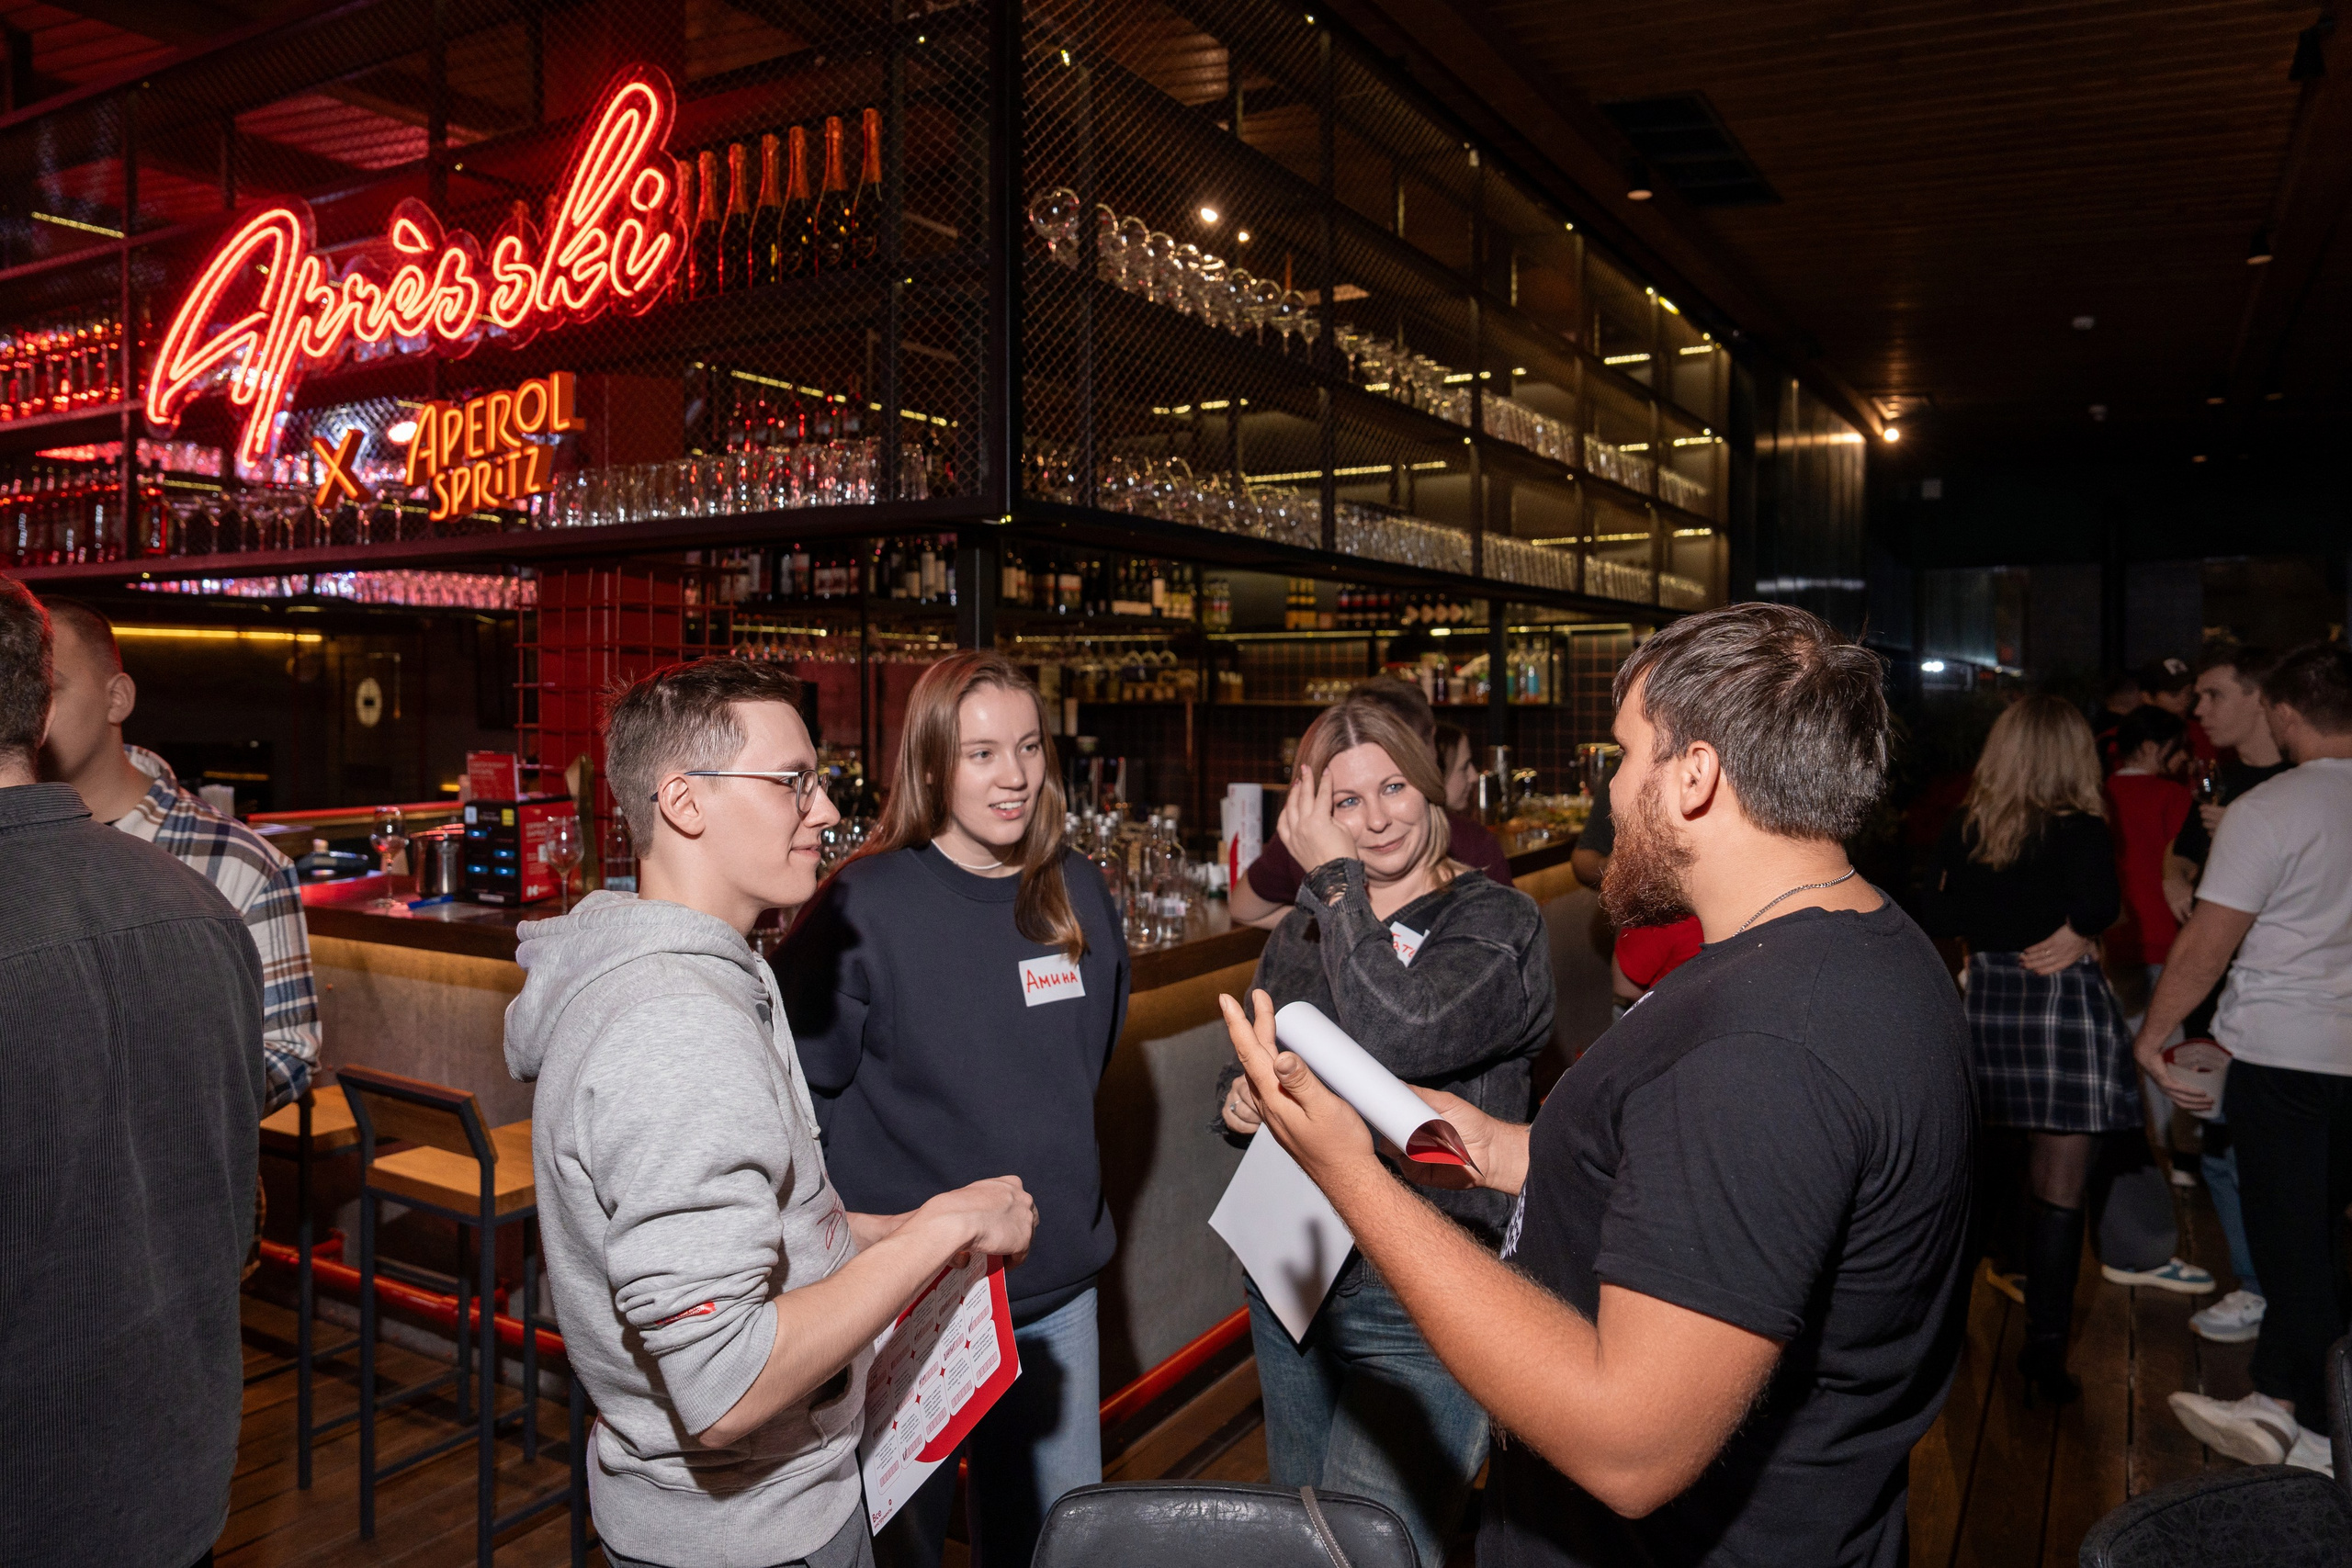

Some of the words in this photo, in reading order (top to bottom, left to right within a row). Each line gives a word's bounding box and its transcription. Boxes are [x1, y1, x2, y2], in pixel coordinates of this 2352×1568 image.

[144, 207, 481, 469] Après
[489, 81, 673, 330] ski
[404, 371, 575, 487] APEROL
